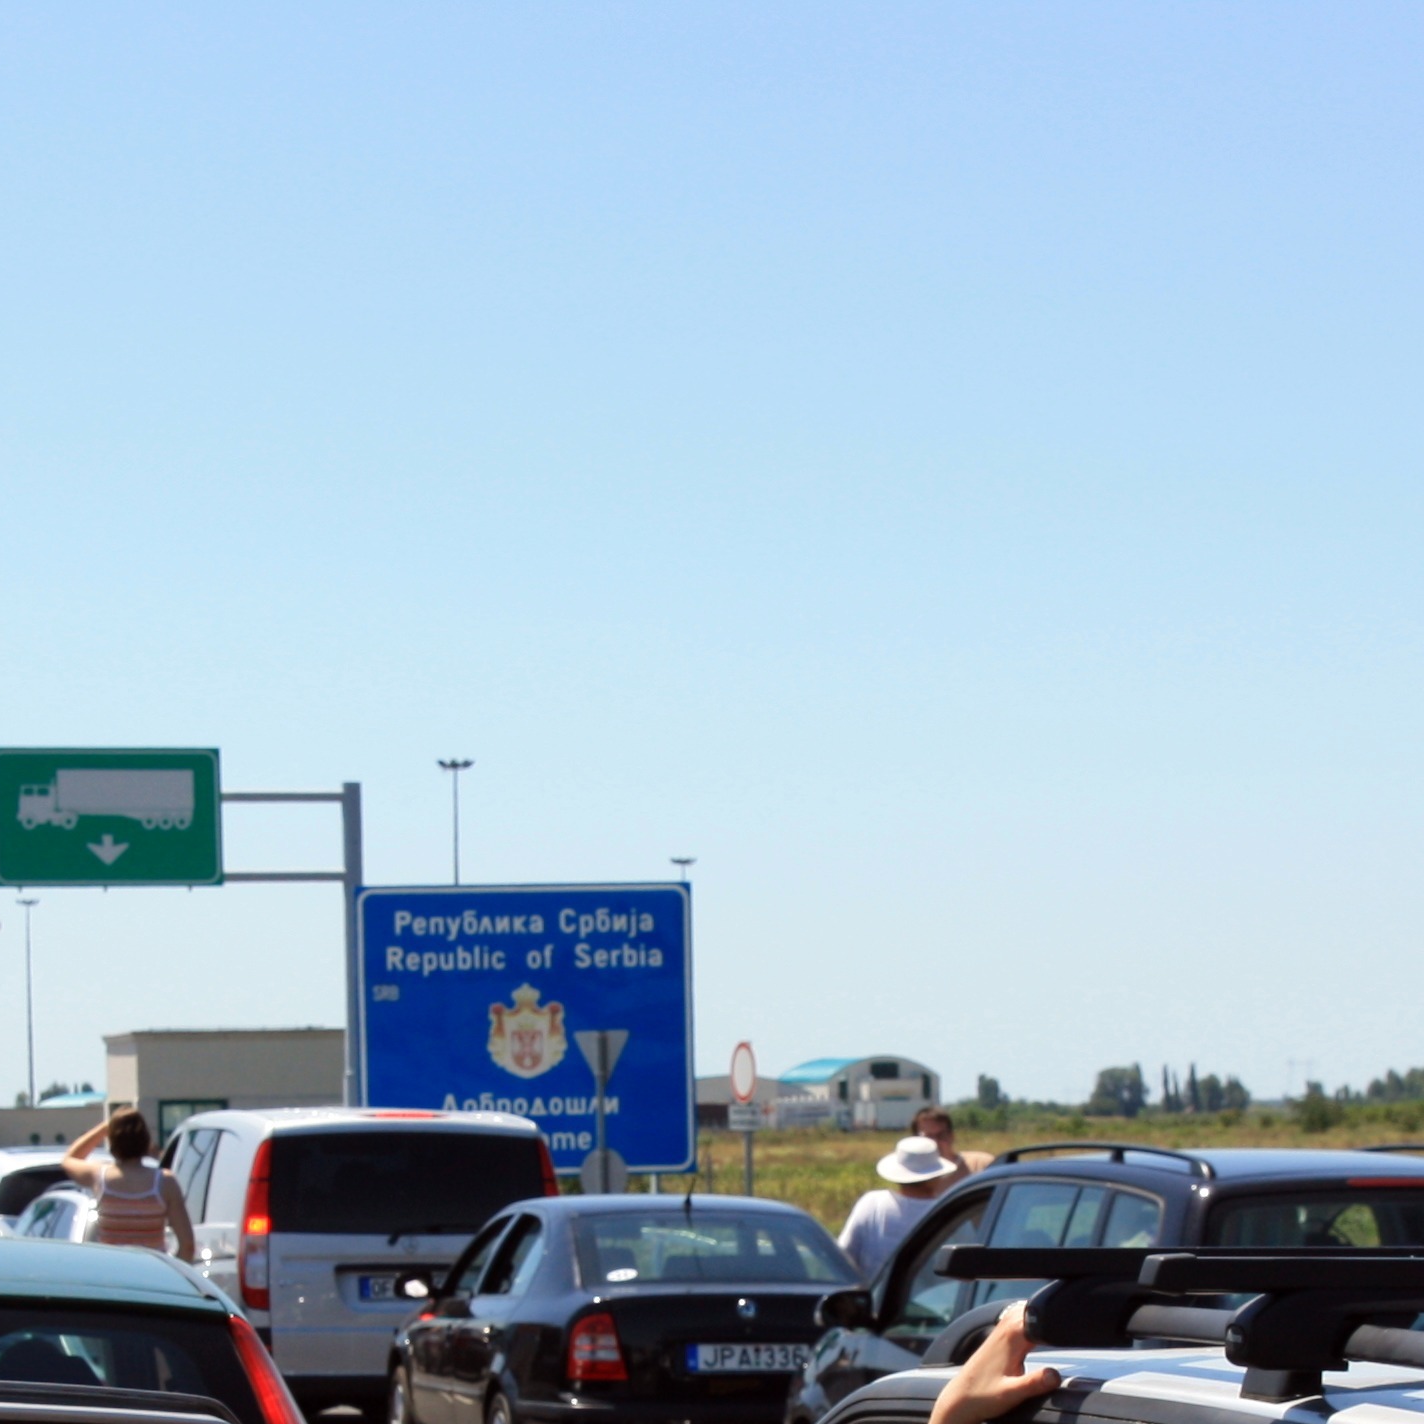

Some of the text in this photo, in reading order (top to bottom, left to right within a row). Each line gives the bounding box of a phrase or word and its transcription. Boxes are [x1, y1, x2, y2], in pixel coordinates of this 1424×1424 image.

[394, 907, 654, 941] Република Србија
[386, 943, 664, 976] Republic of Serbia
